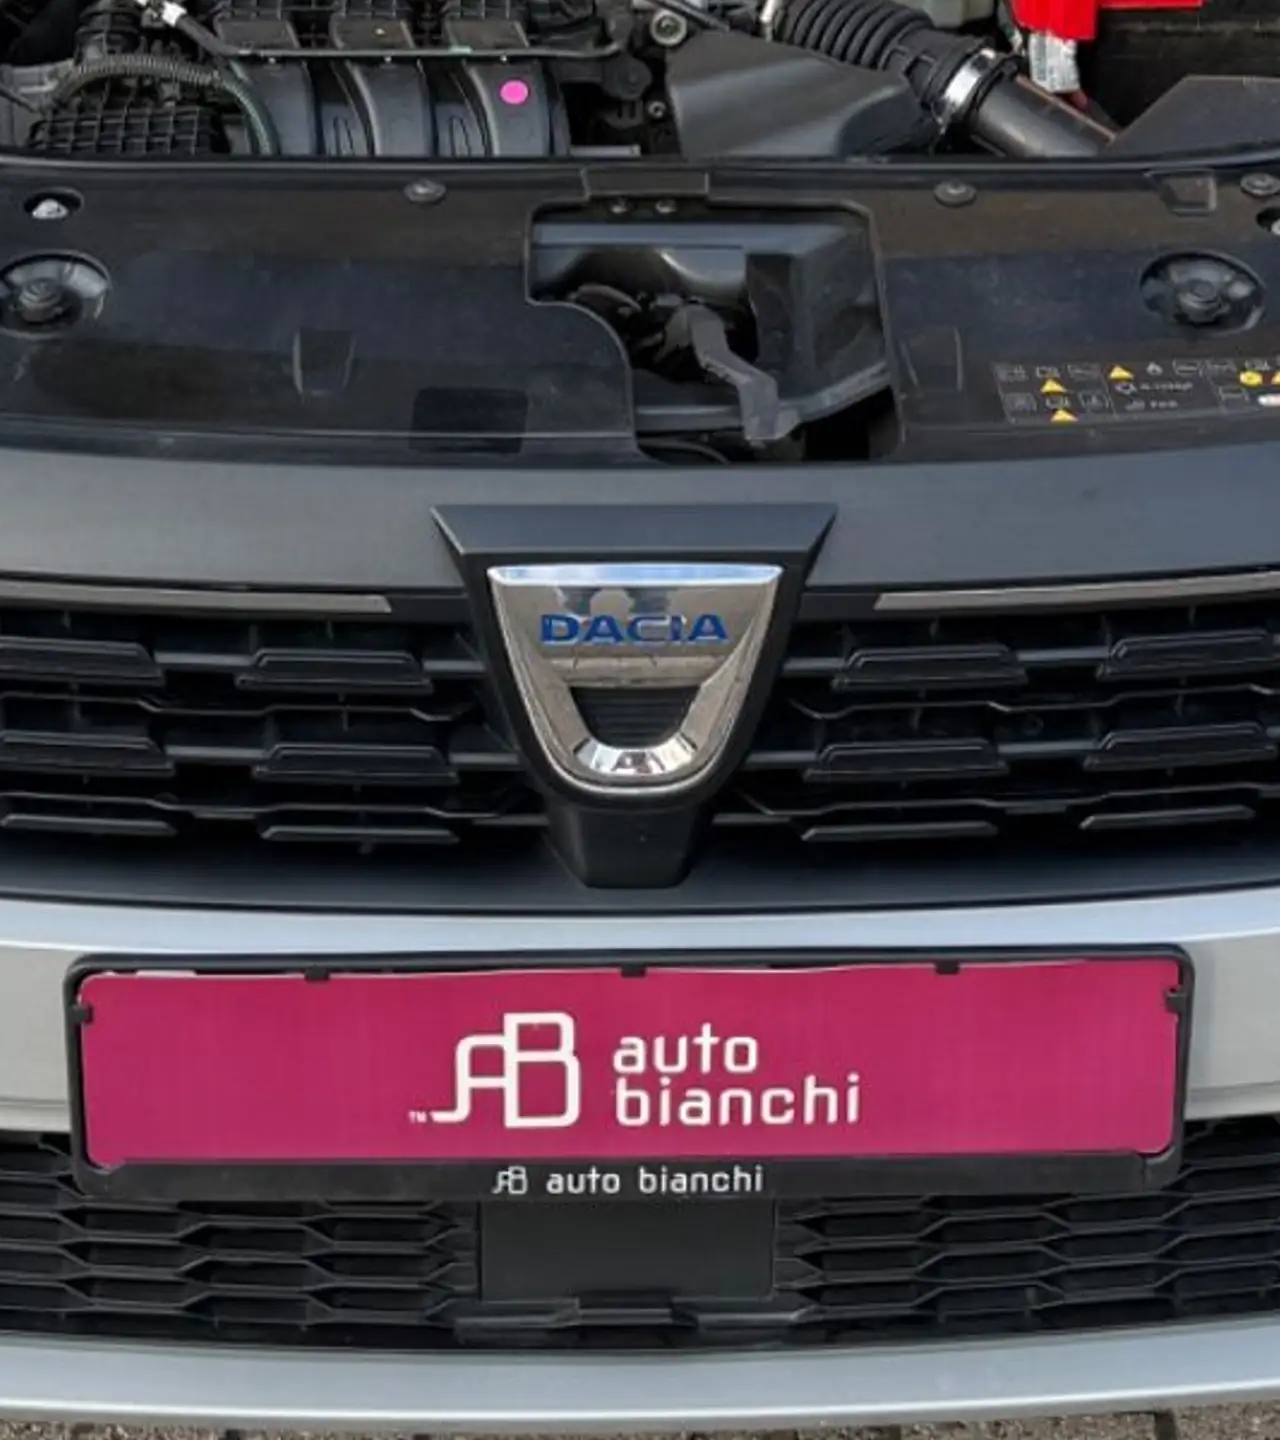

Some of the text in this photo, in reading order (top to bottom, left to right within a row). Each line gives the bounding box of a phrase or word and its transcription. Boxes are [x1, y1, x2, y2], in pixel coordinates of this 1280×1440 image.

[540, 613, 728, 646] DACIA
[612, 1022, 759, 1075] auto
[615, 1072, 860, 1127] bianchi
[546, 1165, 621, 1195] auto
[638, 1164, 764, 1195] bianchi
